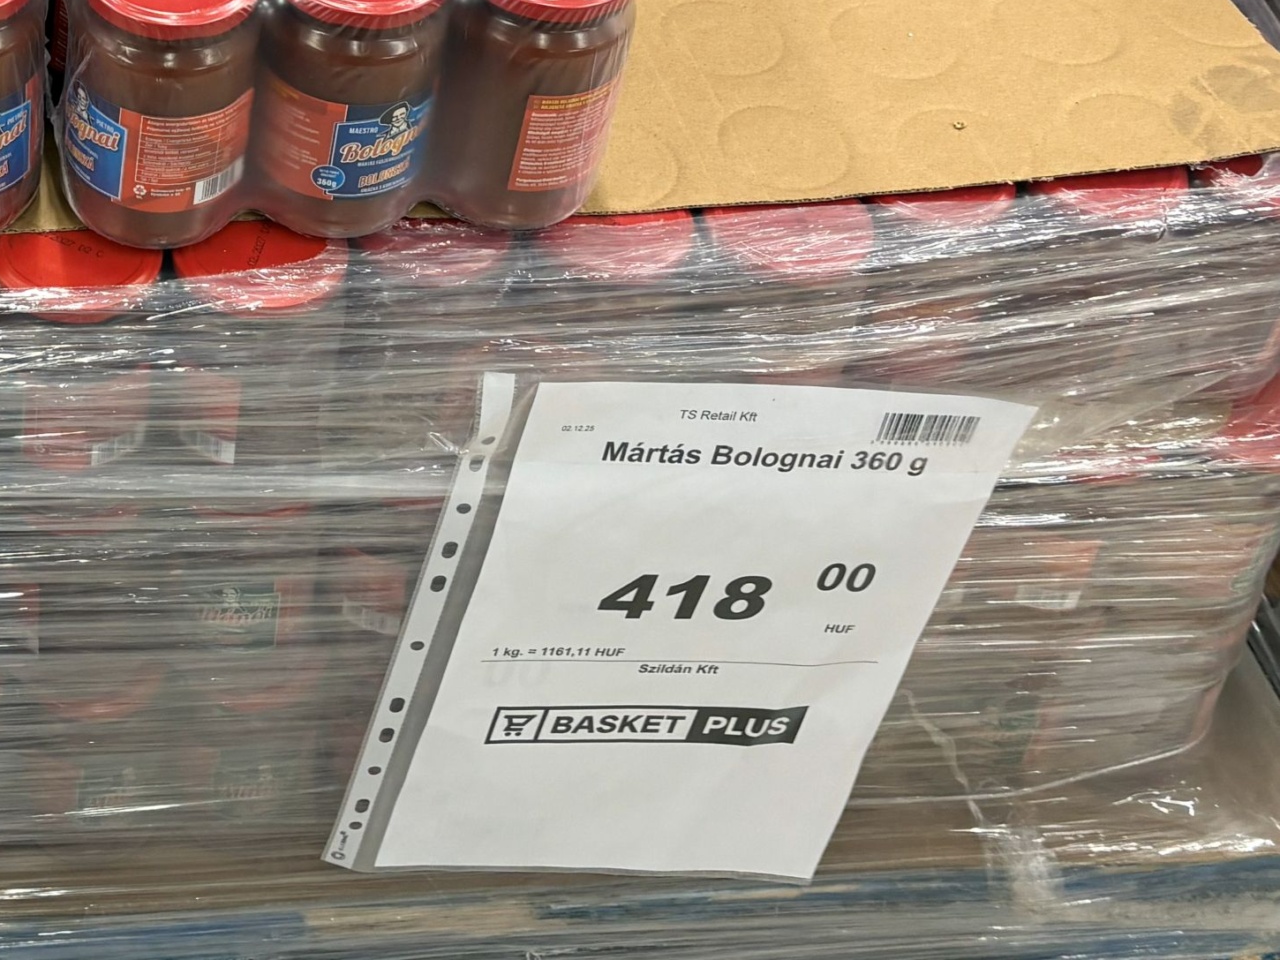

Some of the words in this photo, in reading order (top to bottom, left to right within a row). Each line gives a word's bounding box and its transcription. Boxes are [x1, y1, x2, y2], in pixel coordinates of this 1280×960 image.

[317, 178, 337, 188] 360g
[680, 409, 697, 420] TS
[700, 410, 736, 421] Retail
[739, 411, 758, 423] Kft
[602, 441, 702, 465] Mártás
[711, 444, 845, 473] Bolognai
[850, 450, 903, 471] 360
[907, 456, 928, 477] g
[817, 563, 876, 592] 00
[597, 574, 772, 620] 418
[824, 624, 855, 634] HUF
[492, 648, 499, 656] 1
[502, 647, 523, 658] kg.
[541, 647, 591, 657] 1161,11
[594, 648, 625, 657] HUF
[638, 664, 692, 674] Szildán
[696, 664, 719, 675] Kft
[550, 715, 686, 734] BASKET
[702, 715, 790, 736] PLUS
